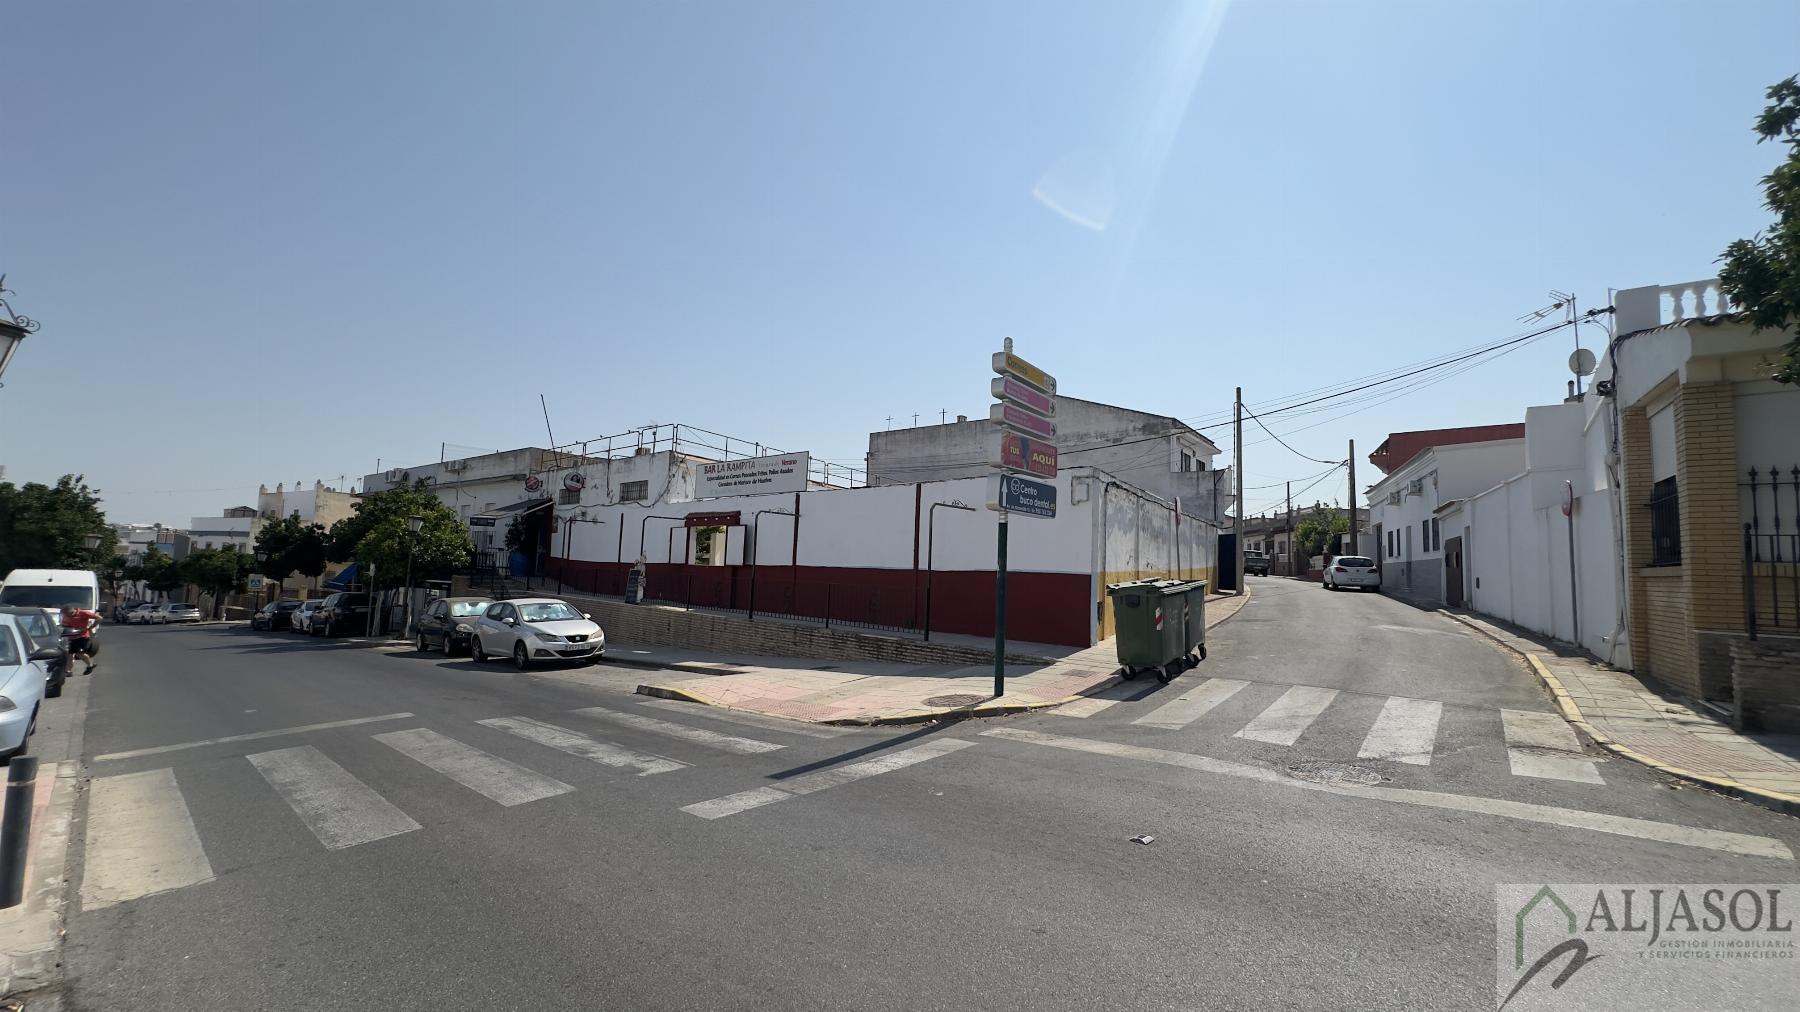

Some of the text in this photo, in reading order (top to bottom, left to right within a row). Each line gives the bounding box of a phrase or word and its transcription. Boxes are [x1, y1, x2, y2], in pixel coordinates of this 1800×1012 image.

[704, 465, 716, 474] BAR
[717, 463, 725, 473] LA
[726, 460, 755, 473] RAMPITA
[1020, 484, 1037, 495] Centro
